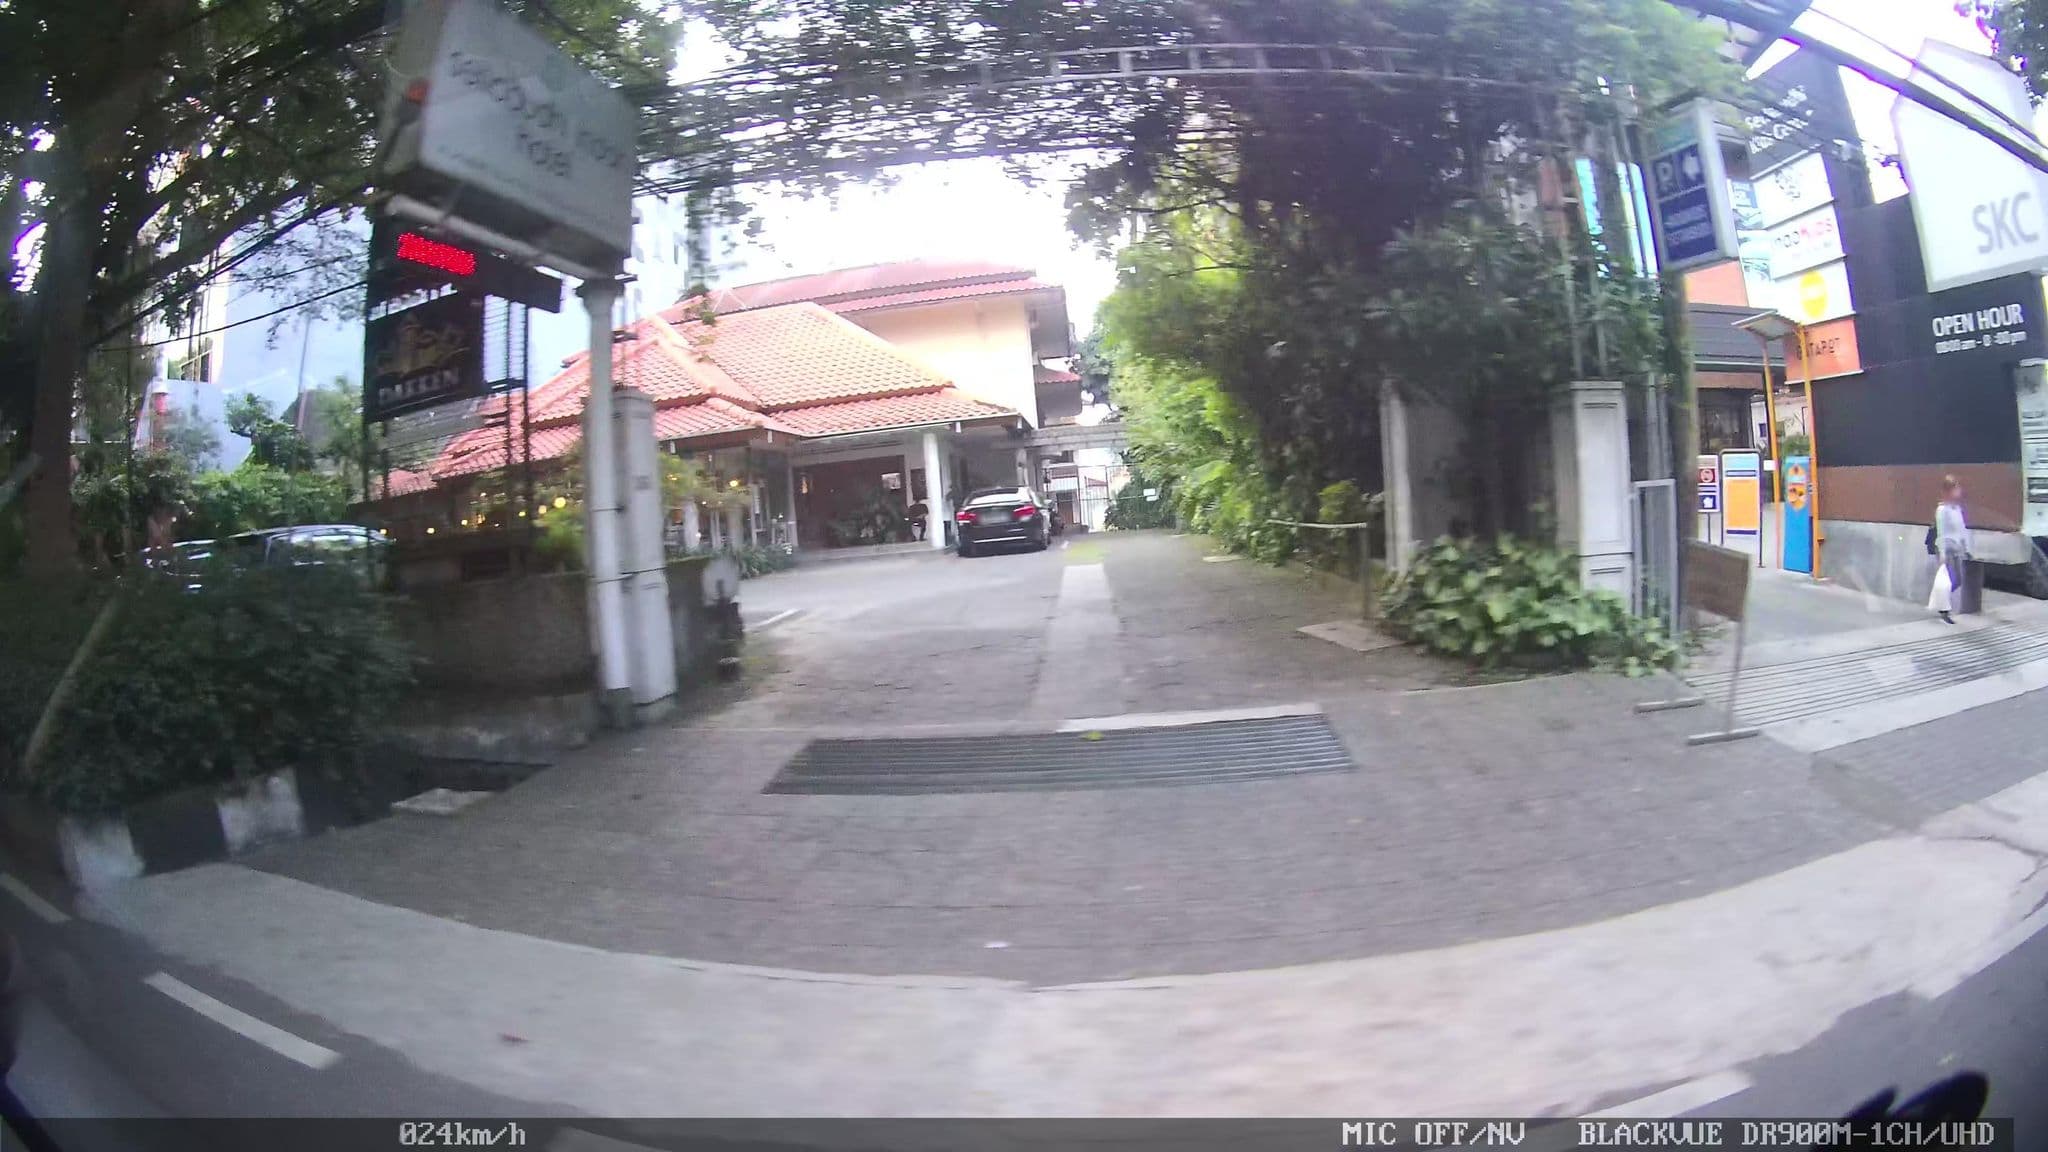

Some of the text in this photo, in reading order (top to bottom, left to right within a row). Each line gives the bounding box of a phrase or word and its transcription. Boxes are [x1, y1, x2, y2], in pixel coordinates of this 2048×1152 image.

[1972, 192, 2040, 254] SKC
[1932, 303, 2024, 337] OPEN HOUR
